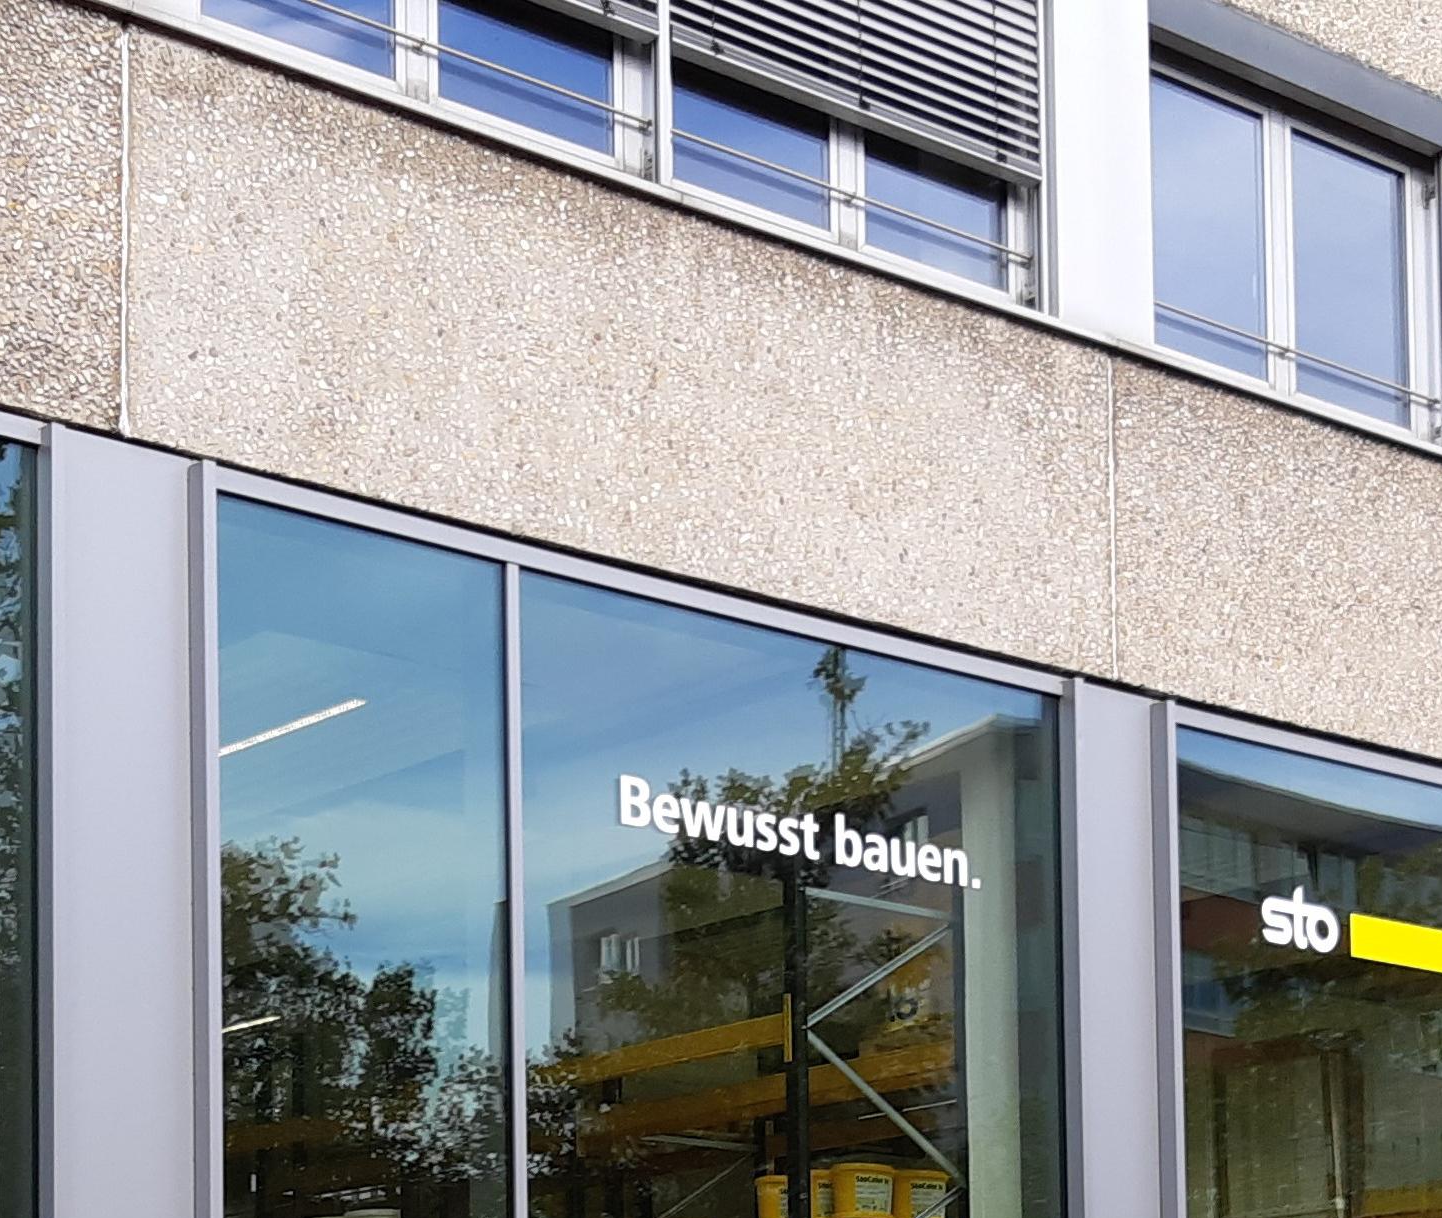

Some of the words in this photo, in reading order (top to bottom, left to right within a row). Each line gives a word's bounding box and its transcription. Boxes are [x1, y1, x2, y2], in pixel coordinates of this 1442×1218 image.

[619, 774, 820, 861] Bewusst
[834, 812, 981, 889] bauen.
[1261, 885, 1340, 954] sto
